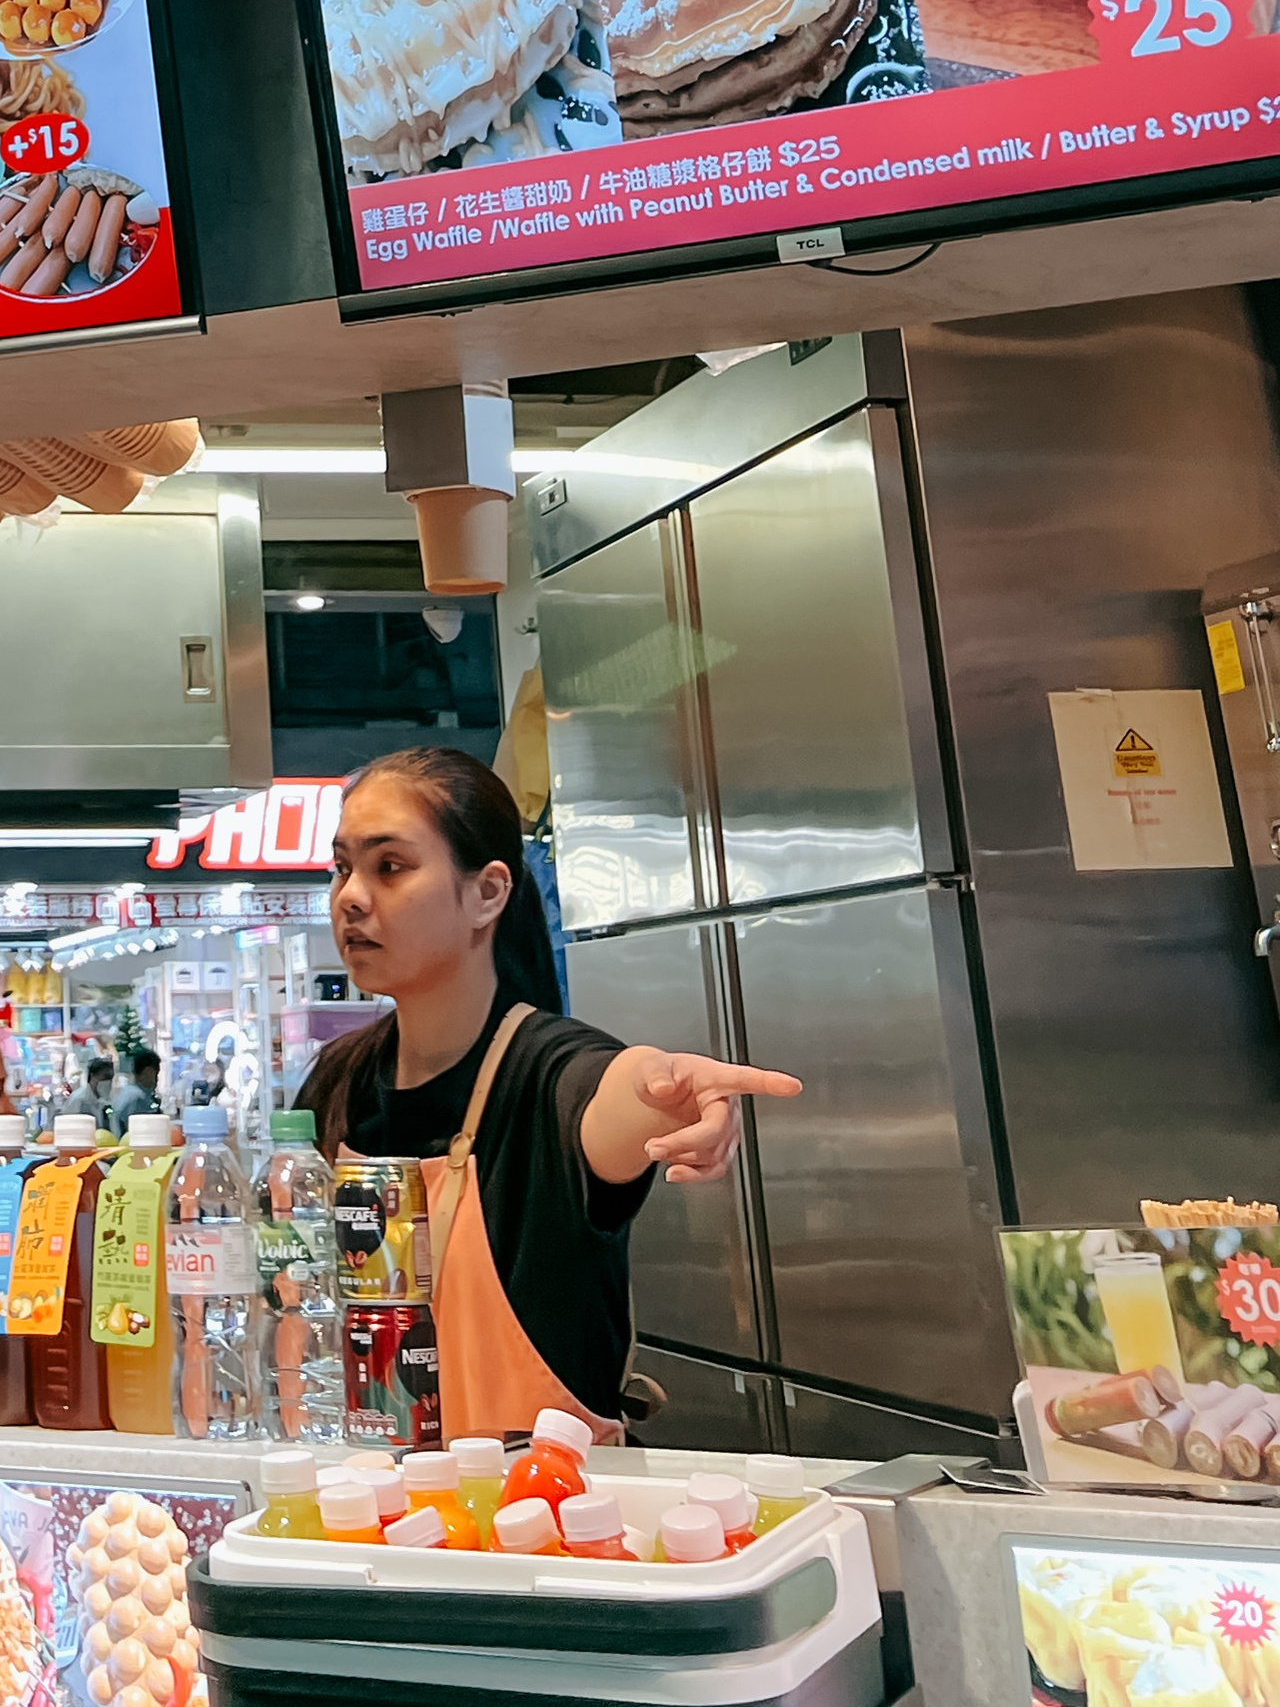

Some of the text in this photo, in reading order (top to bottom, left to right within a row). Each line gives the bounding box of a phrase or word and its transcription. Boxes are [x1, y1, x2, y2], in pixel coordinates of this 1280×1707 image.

[7, 120, 80, 160] +$15
[360, 201, 430, 235] 雞蛋仔
[453, 178, 573, 220] 花生醬甜奶
[598, 145, 773, 196] 牛油糖漿格仔餅
[778, 135, 841, 168] $25
[365, 239, 409, 263] Egg
[412, 224, 483, 253] Waffle
[576, 201, 625, 228] with
[628, 186, 714, 221] Peanut
[718, 177, 790, 208] Butter
[795, 172, 815, 195] &
[819, 145, 971, 191] Condensed
[977, 136, 1035, 166] milk
[1058, 123, 1138, 154] Butter
[1144, 116, 1166, 141] &
[1170, 106, 1251, 139] Syrup
[795, 238, 825, 251] TCL
[257, 1238, 310, 1260] Volvic
